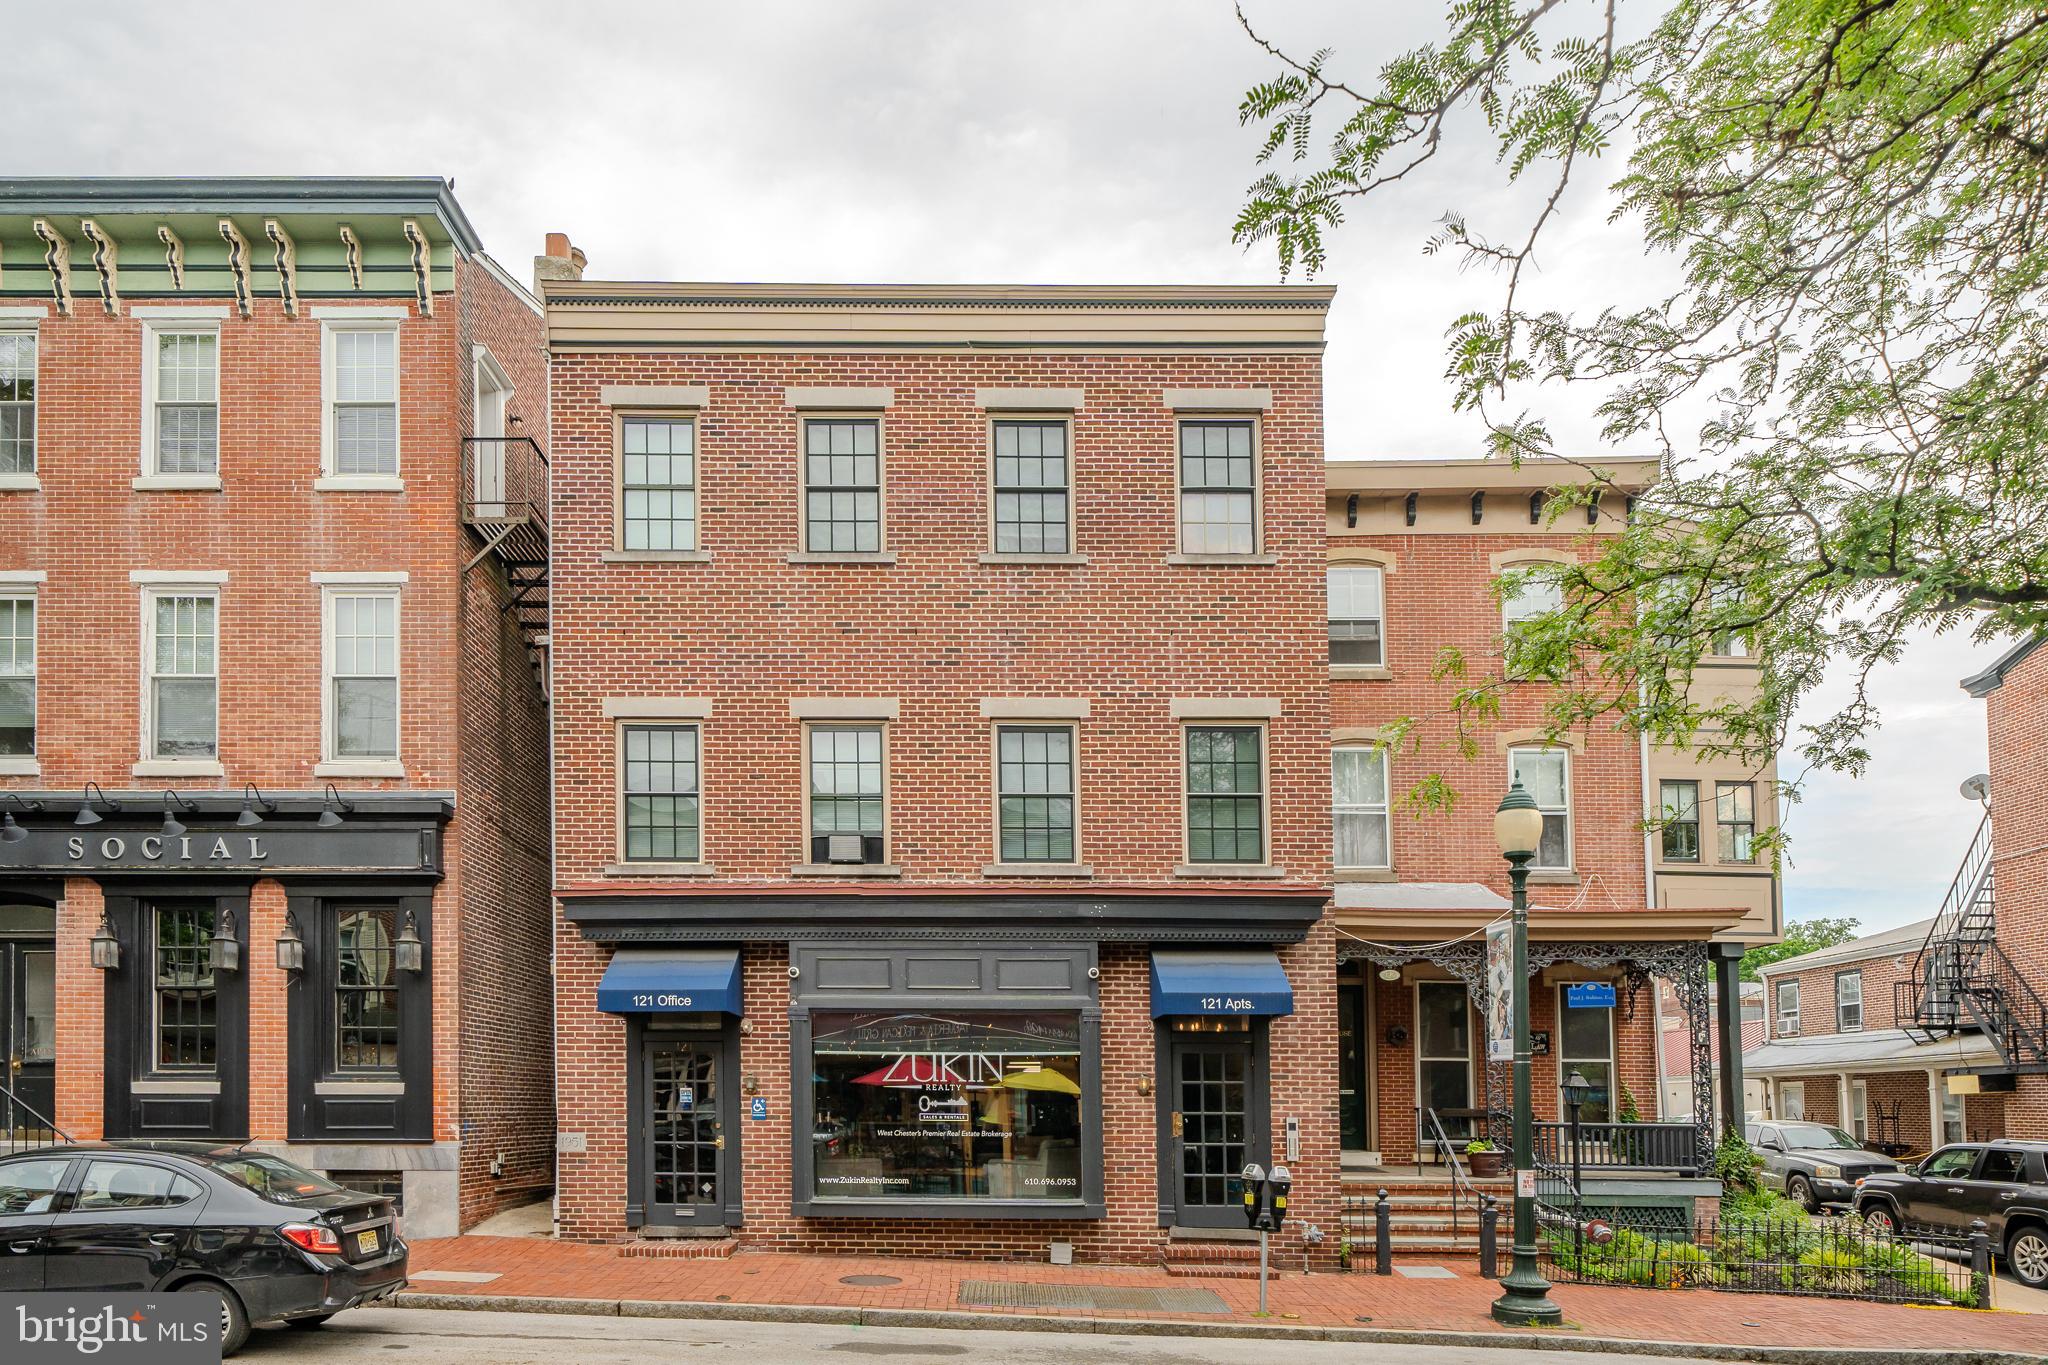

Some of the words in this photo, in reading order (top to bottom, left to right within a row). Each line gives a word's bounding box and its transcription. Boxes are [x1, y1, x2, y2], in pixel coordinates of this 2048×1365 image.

[68, 836, 268, 860] SOCIAL
[632, 995, 653, 1007] 121
[657, 994, 692, 1007] Office
[1201, 997, 1221, 1009] 121
[1224, 997, 1255, 1012] Apts.
[1530, 1042, 1546, 1050] LAW
[881, 1052, 1003, 1083] ZUKIN
[877, 1129, 893, 1137] West
[893, 1129, 921, 1137] Chester's
[922, 1129, 946, 1137] Premier
[946, 1129, 961, 1137] Real
[981, 1130, 1013, 1139] Brokerage
[819, 1176, 910, 1185] www.ZukinRealtyInc.com
[1024, 1177, 1077, 1186] 610.696.0953
